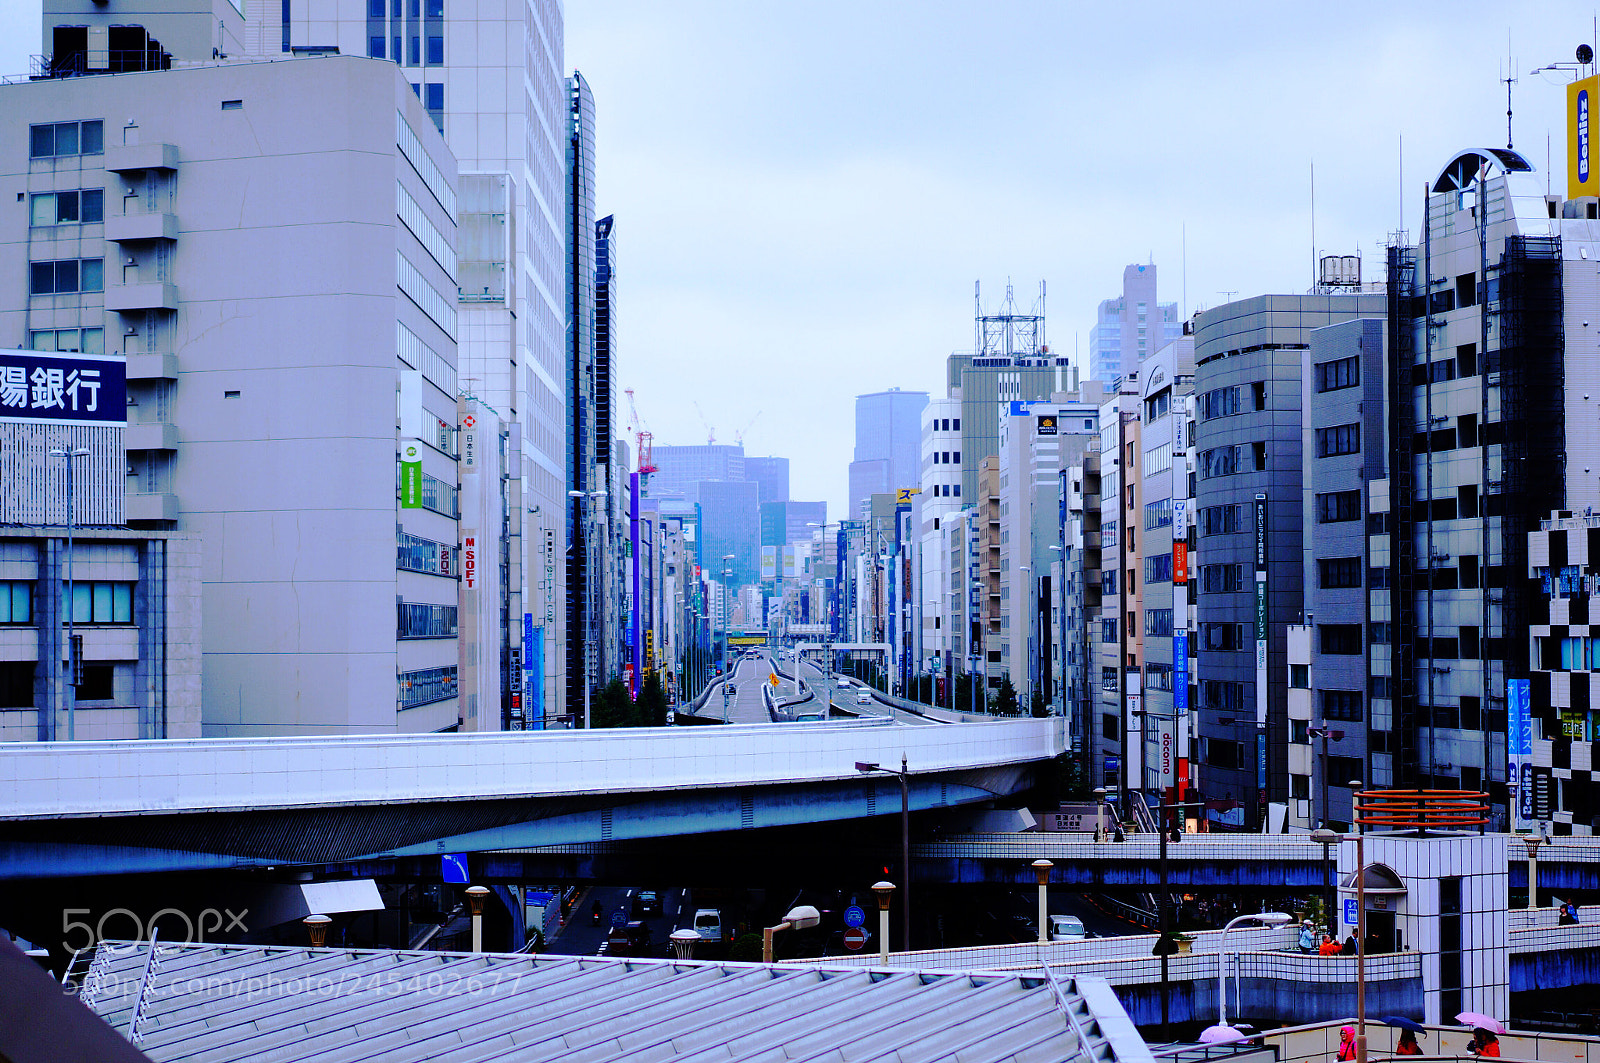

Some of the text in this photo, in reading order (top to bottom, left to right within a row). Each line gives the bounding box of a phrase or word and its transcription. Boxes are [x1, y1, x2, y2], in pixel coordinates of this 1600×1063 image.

[1579, 98, 1588, 174] Berlitz
[0, 366, 101, 411] 陽銀行
[1163, 733, 1173, 775] docomo
[1522, 768, 1532, 815] Berlitz
